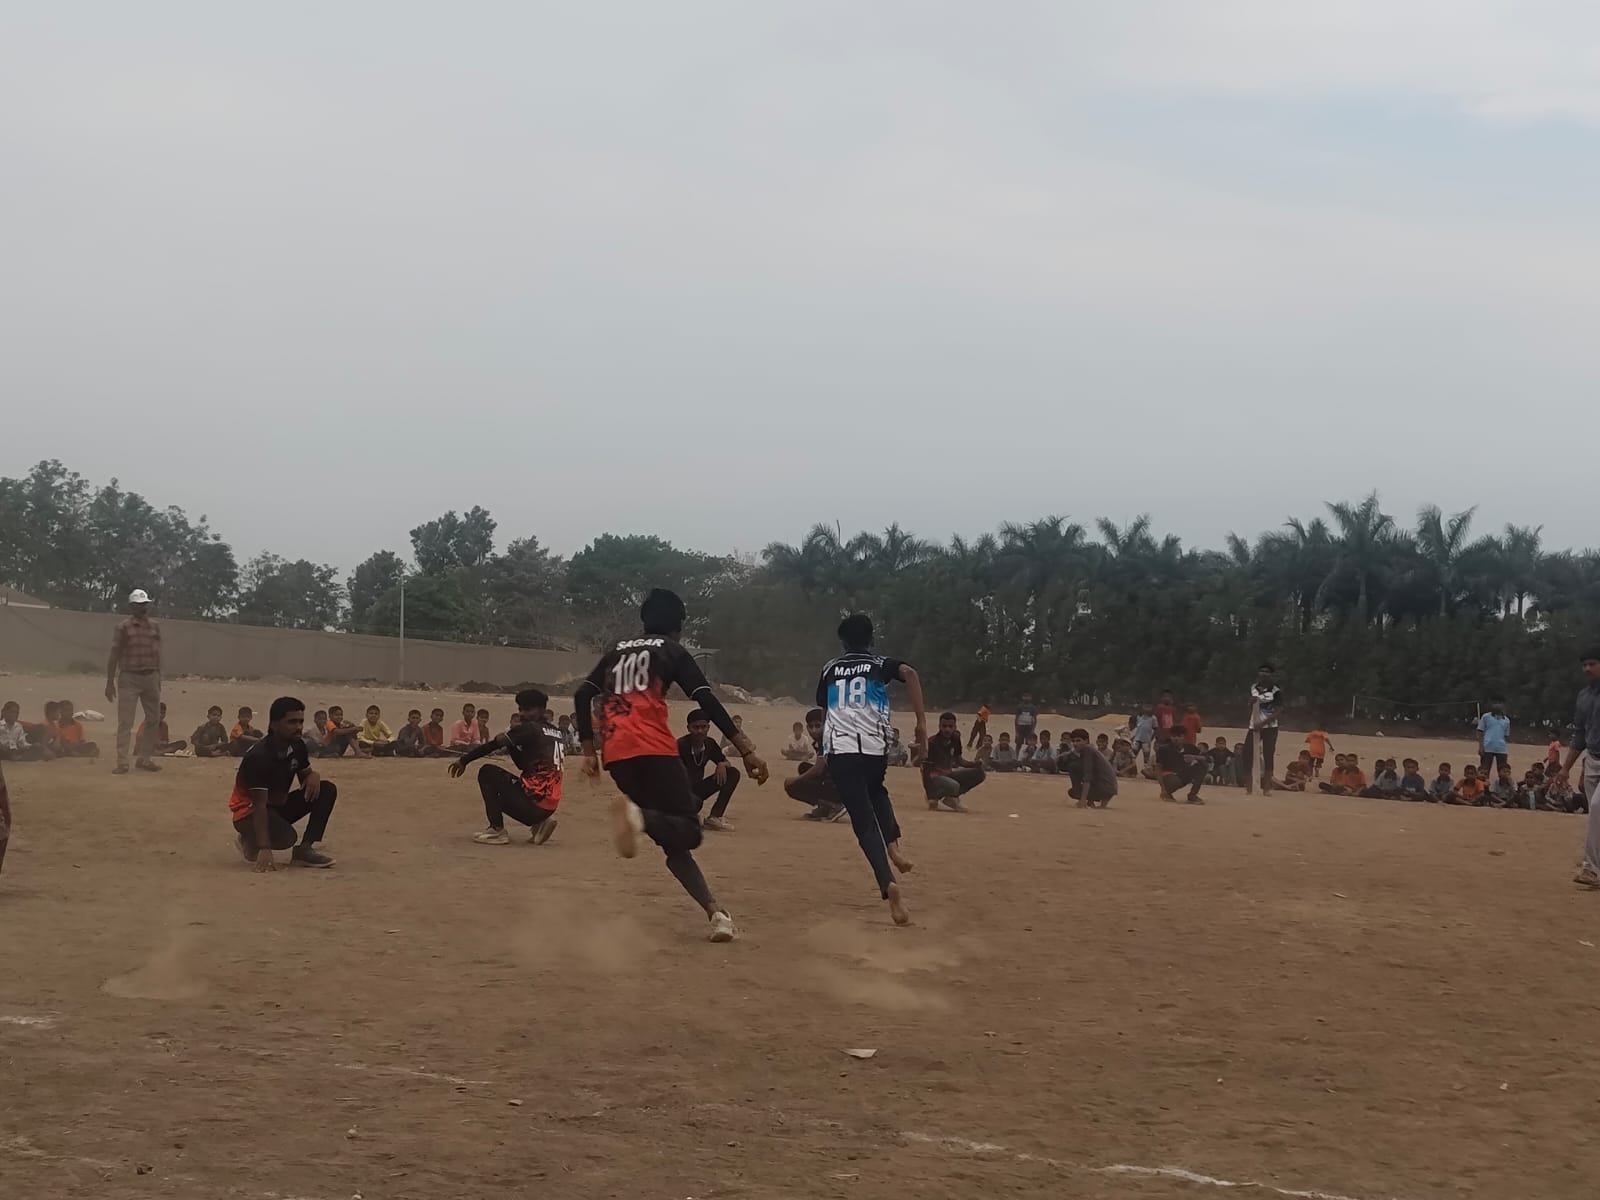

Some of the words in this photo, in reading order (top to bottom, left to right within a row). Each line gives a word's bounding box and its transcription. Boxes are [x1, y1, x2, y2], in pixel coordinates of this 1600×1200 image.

[616, 638, 664, 650] SAGAR
[612, 650, 650, 694] 108
[834, 663, 871, 676] MAYUR
[835, 676, 866, 709] 18
